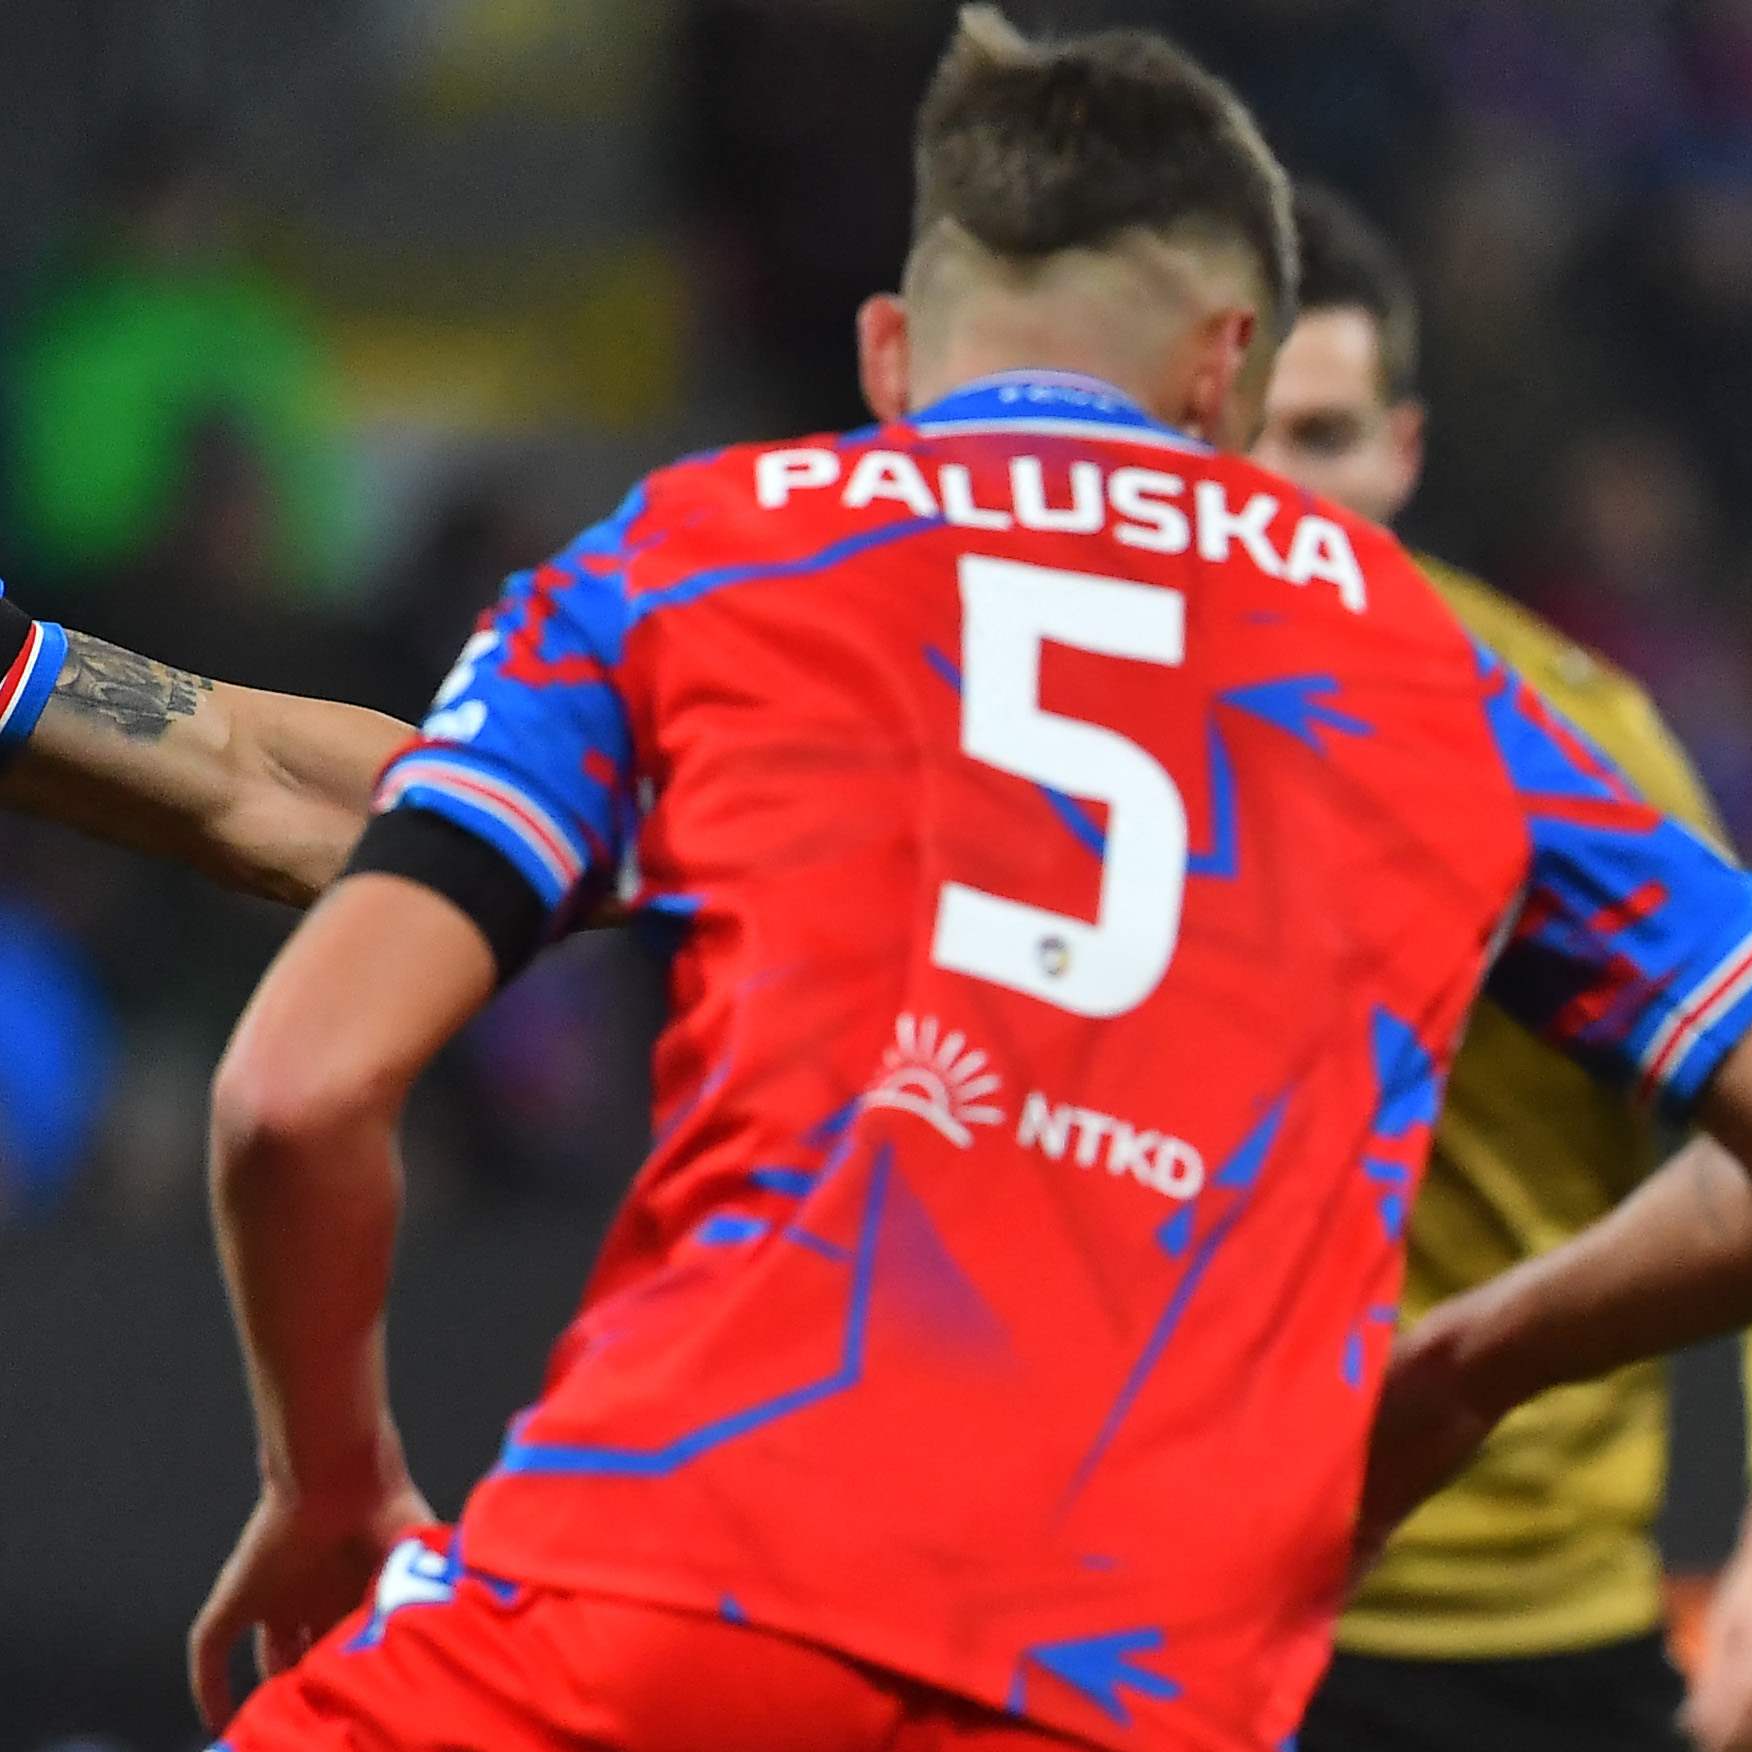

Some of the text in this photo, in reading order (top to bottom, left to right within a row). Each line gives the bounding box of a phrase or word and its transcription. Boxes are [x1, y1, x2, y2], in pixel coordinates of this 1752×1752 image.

[754, 447, 1367, 614] PALUSKA
[931, 552, 1189, 1019] 5
[1016, 1090, 1205, 1202] NTKD
